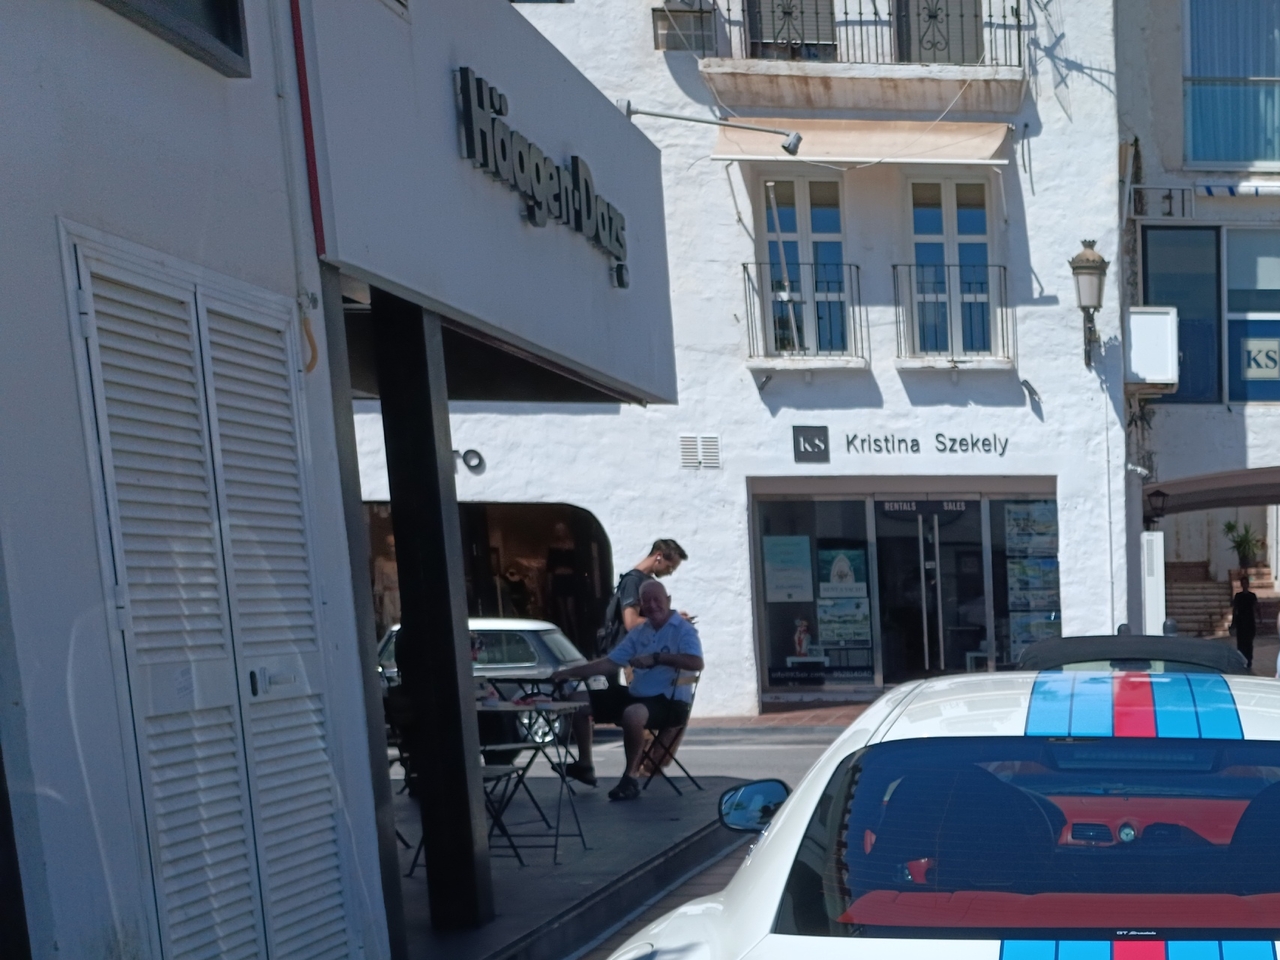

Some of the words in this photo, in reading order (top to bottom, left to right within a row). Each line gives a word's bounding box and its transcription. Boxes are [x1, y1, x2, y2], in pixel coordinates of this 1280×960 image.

[1245, 349, 1278, 369] KS
[846, 433, 921, 454] Kristina
[935, 433, 1009, 458] Szekely
[884, 502, 917, 511] RENTALS
[943, 502, 966, 511] SALES
